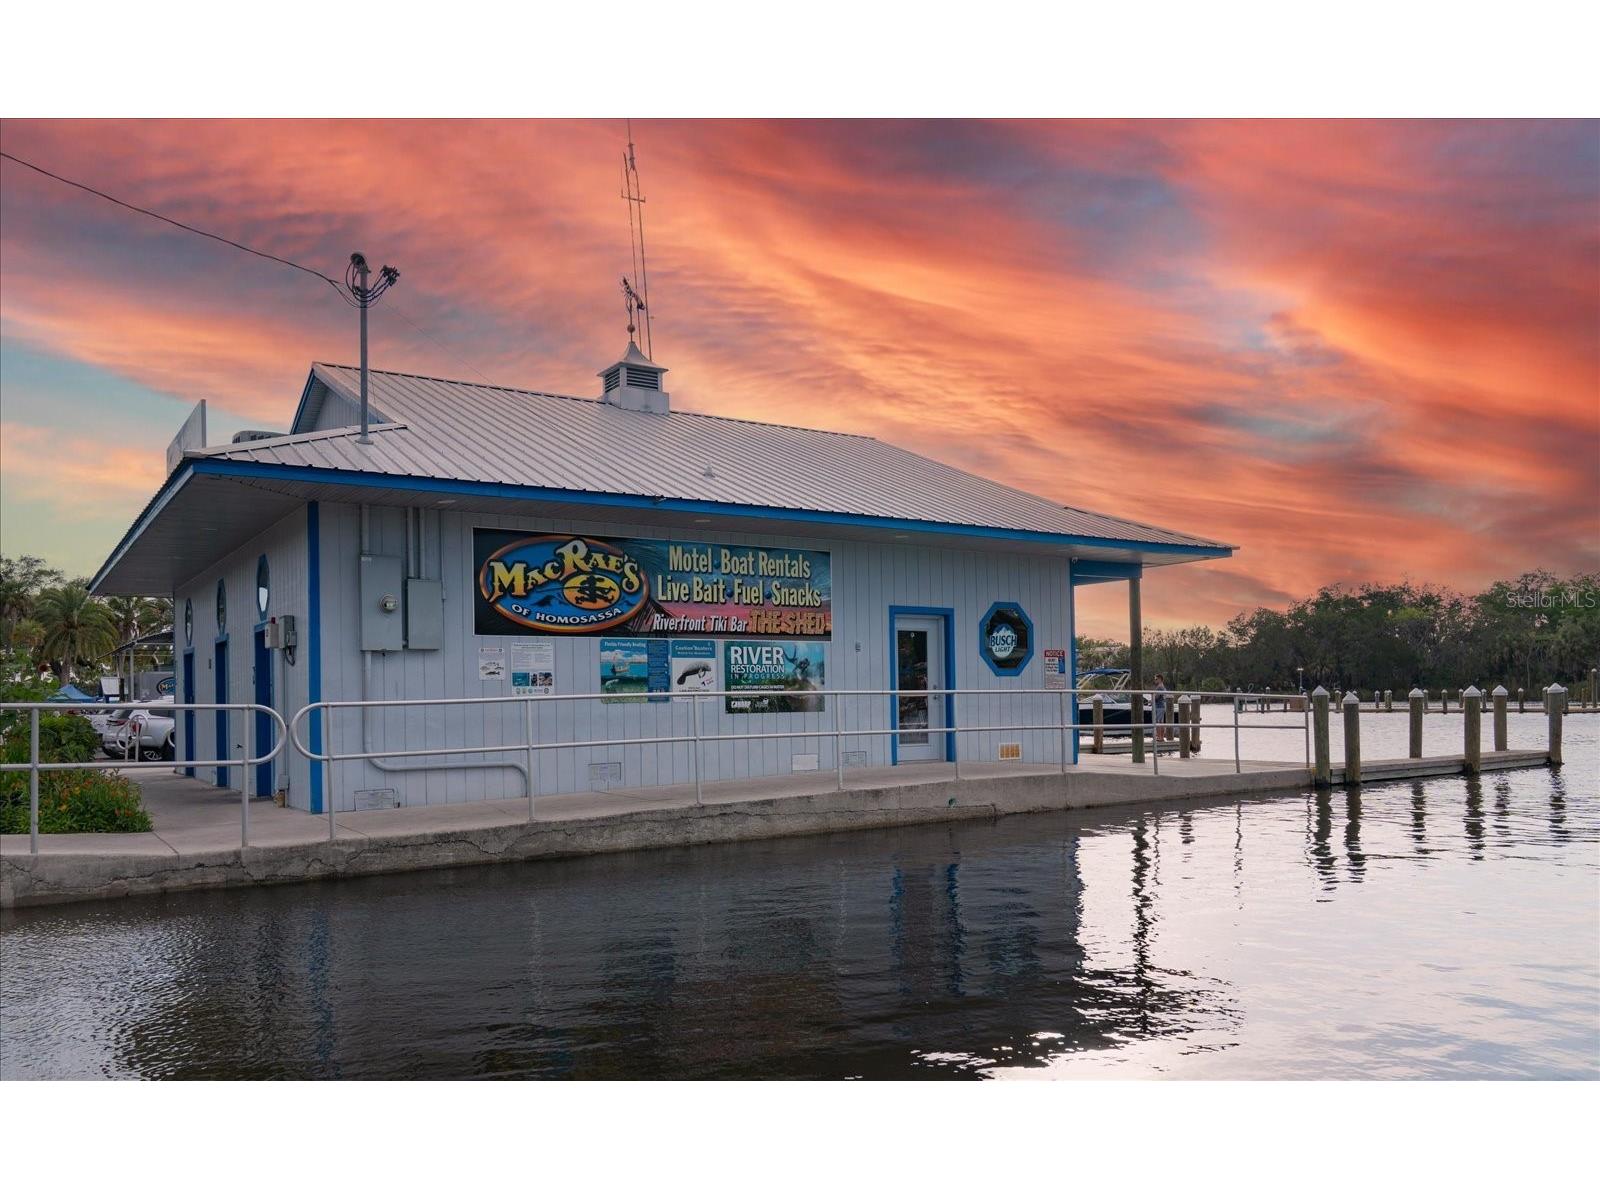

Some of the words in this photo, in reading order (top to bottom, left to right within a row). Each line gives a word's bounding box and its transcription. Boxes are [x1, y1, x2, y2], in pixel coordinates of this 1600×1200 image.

[669, 545, 712, 573] Motel
[721, 548, 754, 576] Boat
[759, 552, 811, 579] Rentals
[657, 575, 690, 601] Live
[693, 576, 726, 603] Bait
[734, 579, 764, 605] Fuel
[771, 580, 822, 607] Snacks
[512, 604, 530, 616] OF
[535, 607, 622, 625] HOMOSASSA
[652, 613, 706, 631] Riverfront
[709, 615, 727, 631] Tiki
[731, 616, 748, 632] Bar
[750, 609, 782, 633] THE
[784, 611, 826, 635] SHED
[991, 635, 1017, 647] BUSCH
[730, 646, 784, 664] RIVER
[730, 664, 785, 674] RESTORATION
